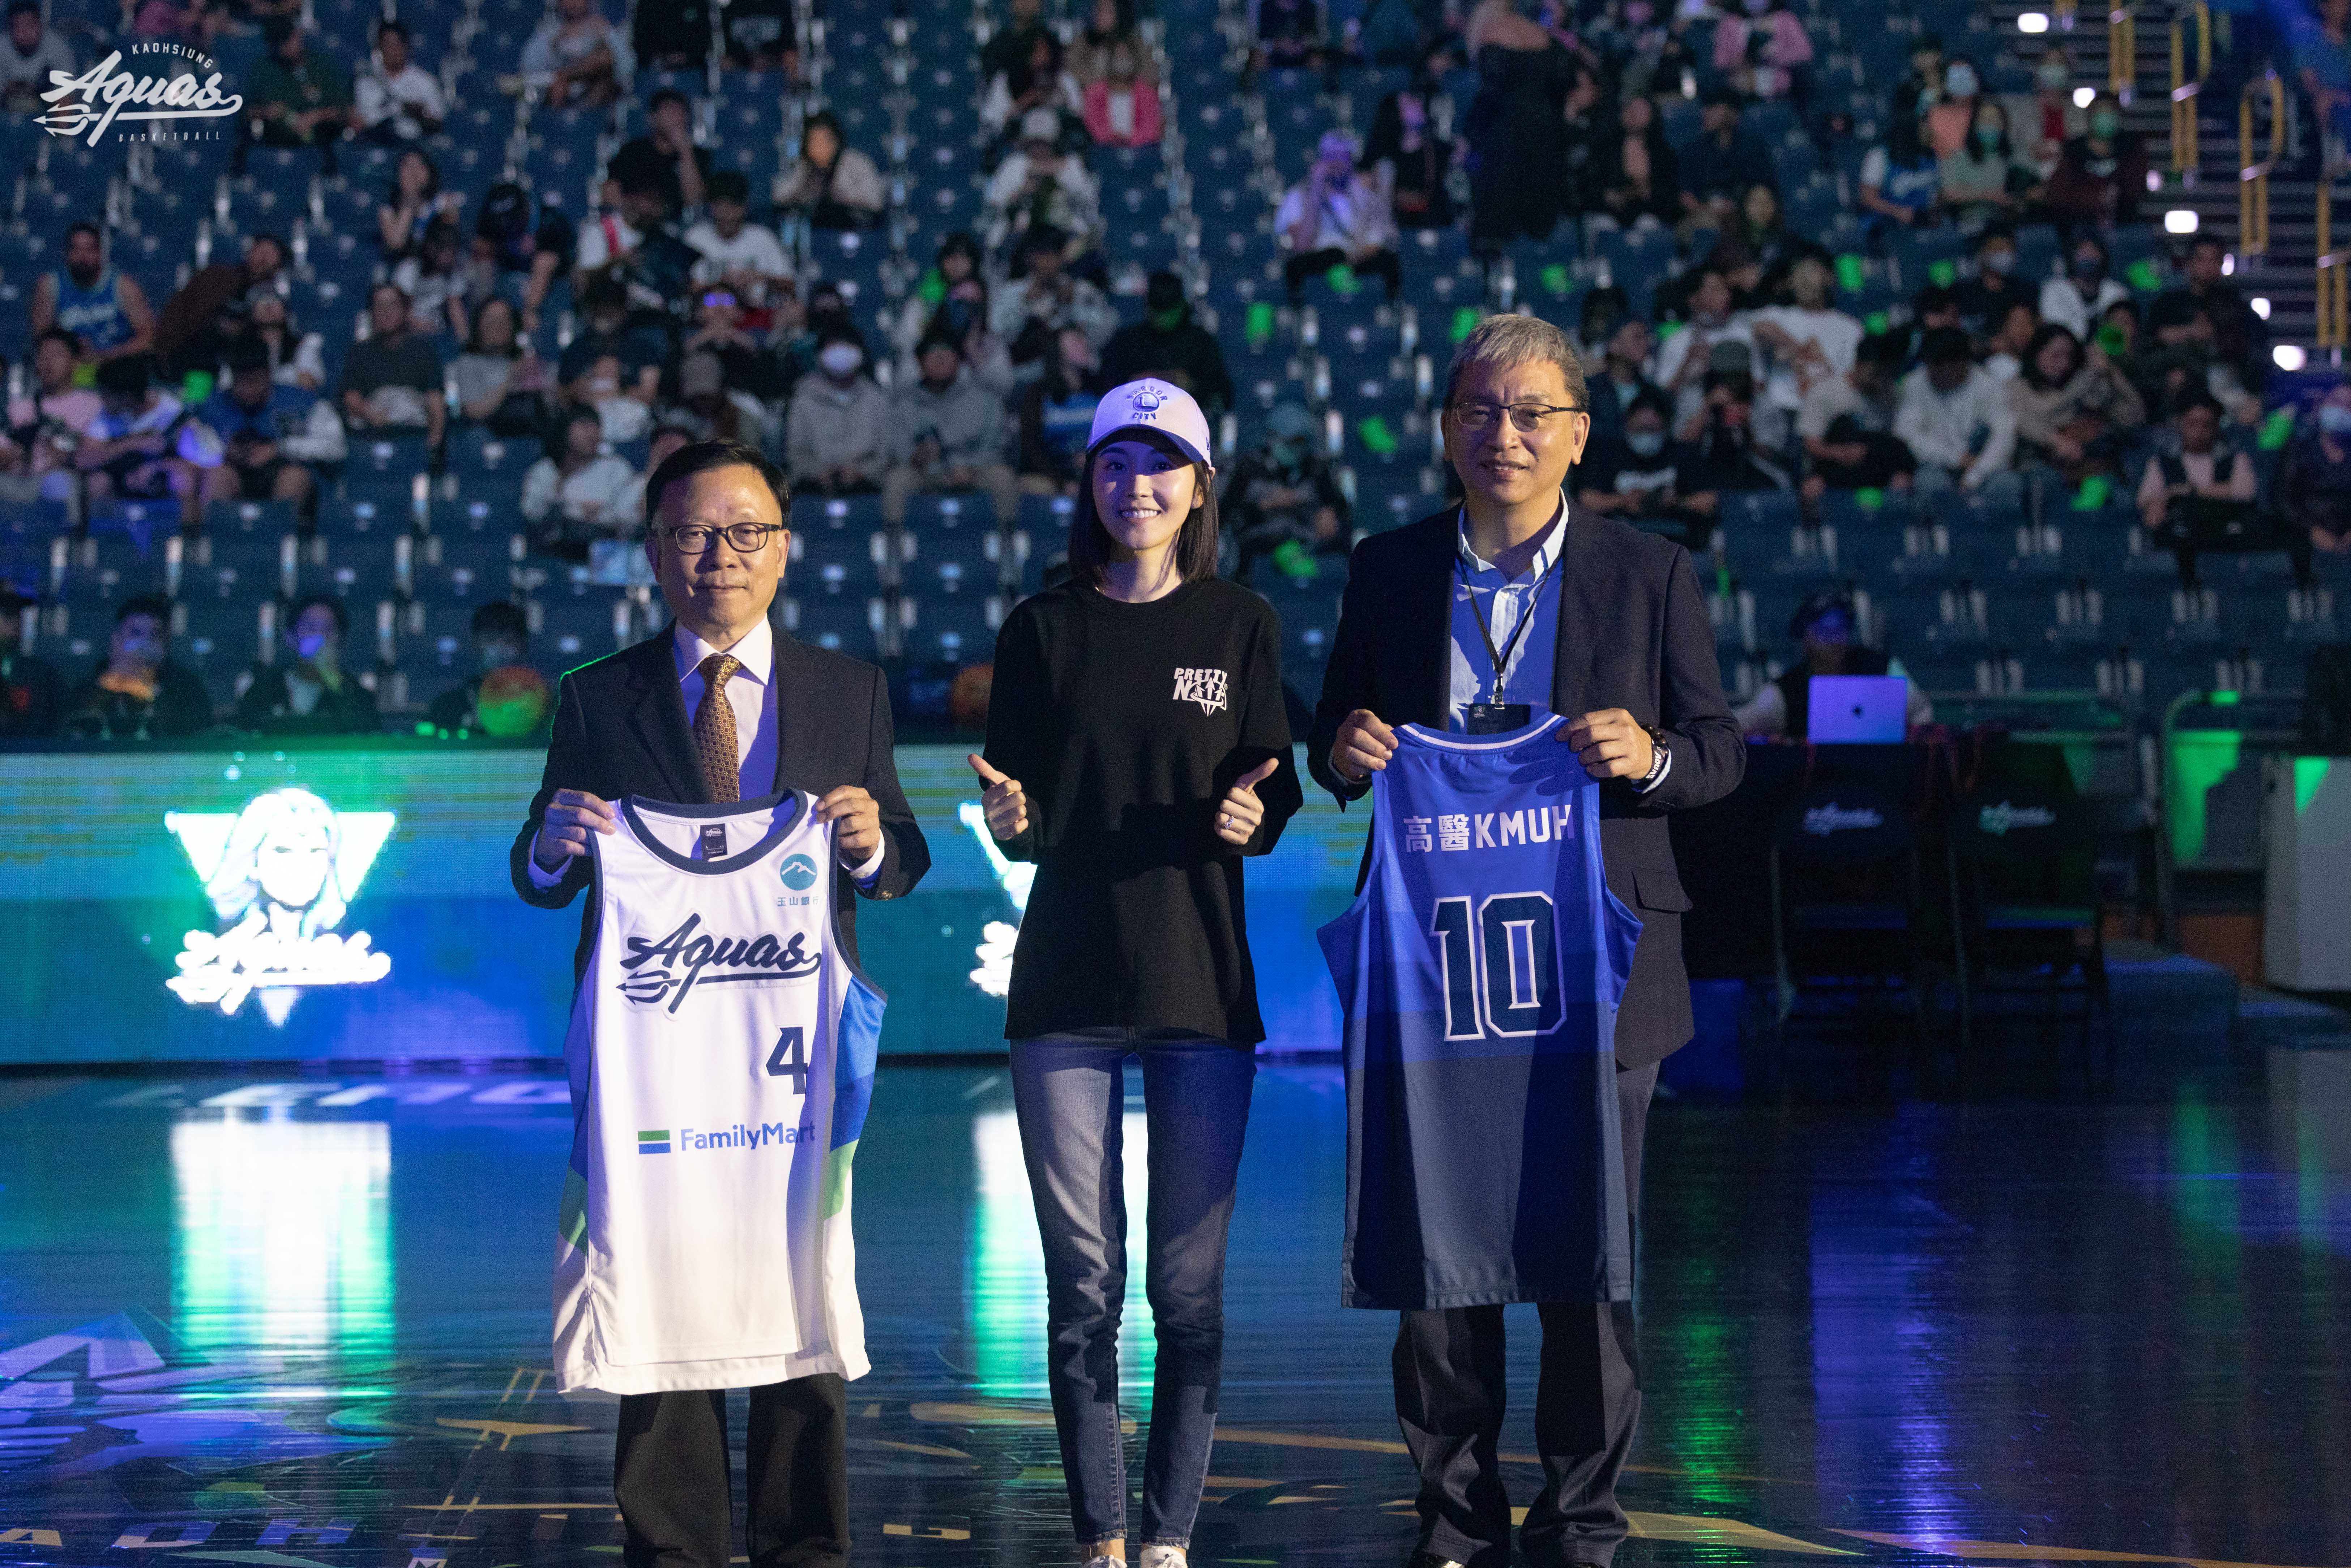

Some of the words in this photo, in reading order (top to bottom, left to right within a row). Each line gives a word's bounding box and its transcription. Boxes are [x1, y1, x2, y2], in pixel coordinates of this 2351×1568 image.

[1126, 386, 1168, 401] HARBOR
[1174, 668, 1227, 689] PRETTY
[619, 913, 821, 1014] Aquas
[1428, 890, 1567, 1042] 10
[765, 1026, 808, 1095] 4
[680, 1121, 816, 1151] FamilyMart
